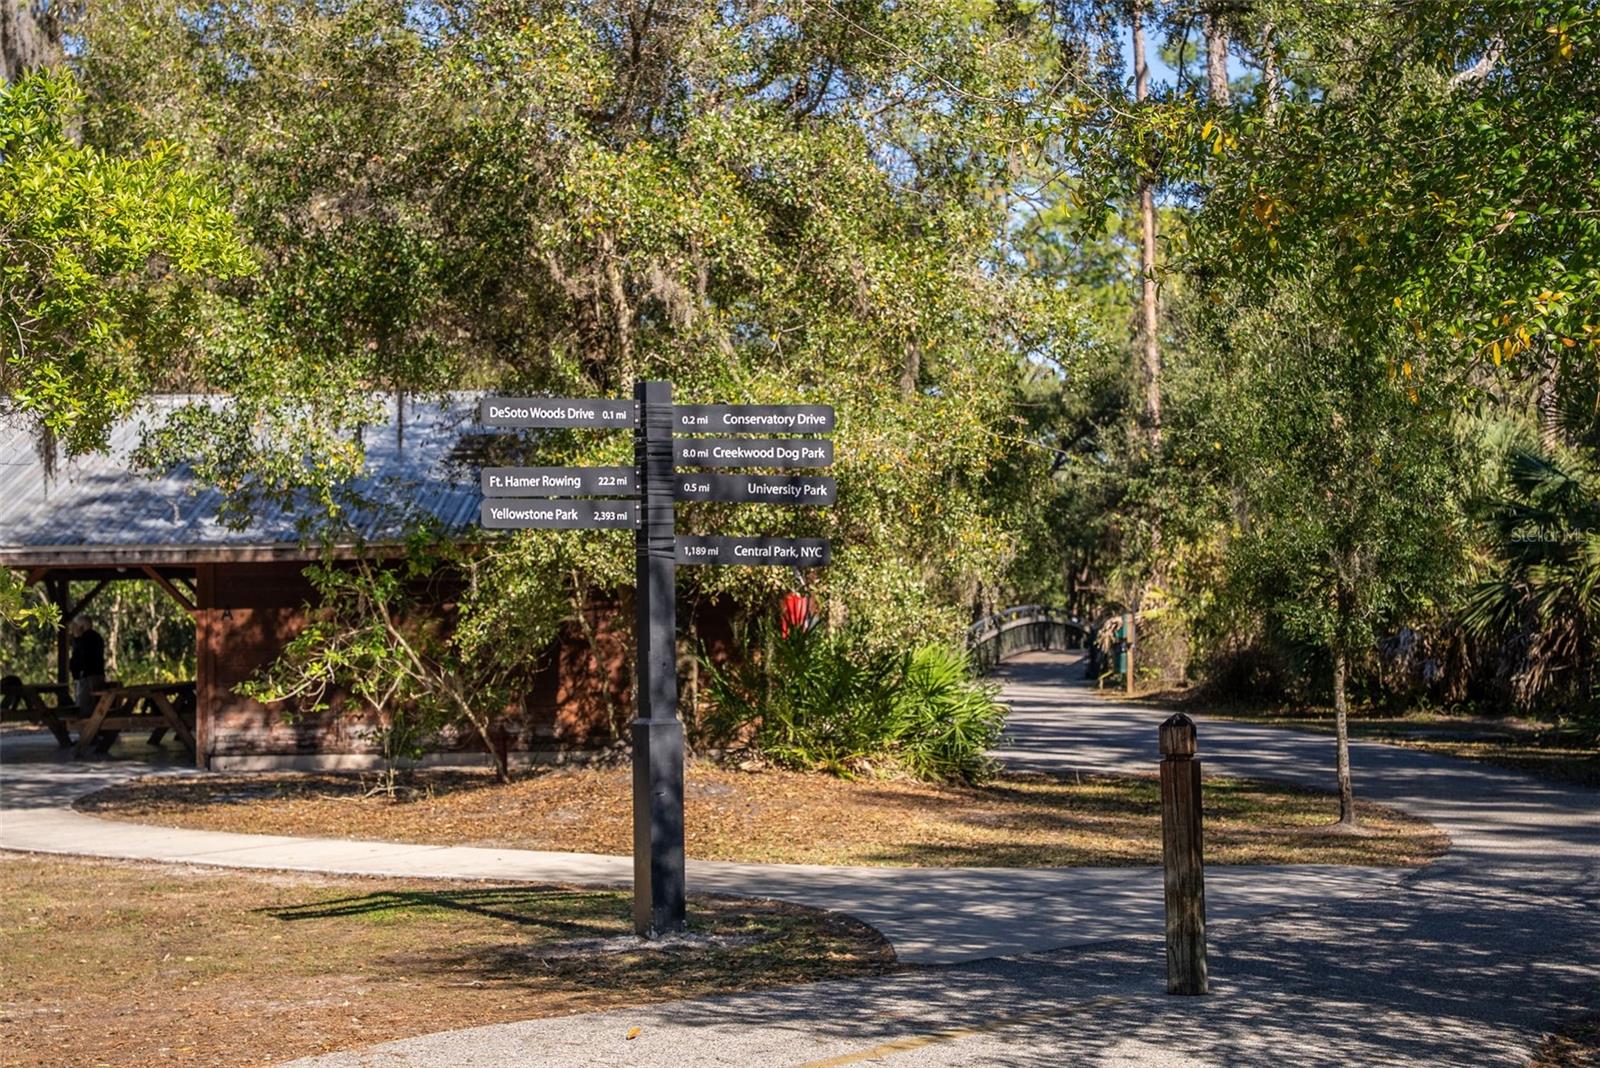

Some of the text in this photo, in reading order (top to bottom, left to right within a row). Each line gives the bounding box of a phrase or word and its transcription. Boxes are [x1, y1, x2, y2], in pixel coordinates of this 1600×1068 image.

[490, 407, 626, 420] DeSoto Woods Drive 0.1 mi
[682, 413, 826, 427] 0.2 mi Conservatory Drive
[683, 447, 826, 460] 8.0 mi Creekwood Dog Park
[490, 476, 627, 490] Ft. Hamer Rowing 22.2 mi
[684, 483, 827, 497] 0.5 mi University Park
[491, 508, 627, 521] Yellowstone Park 2,393 mi
[684, 545, 823, 559] 1,189 mi Central Park, NYC
